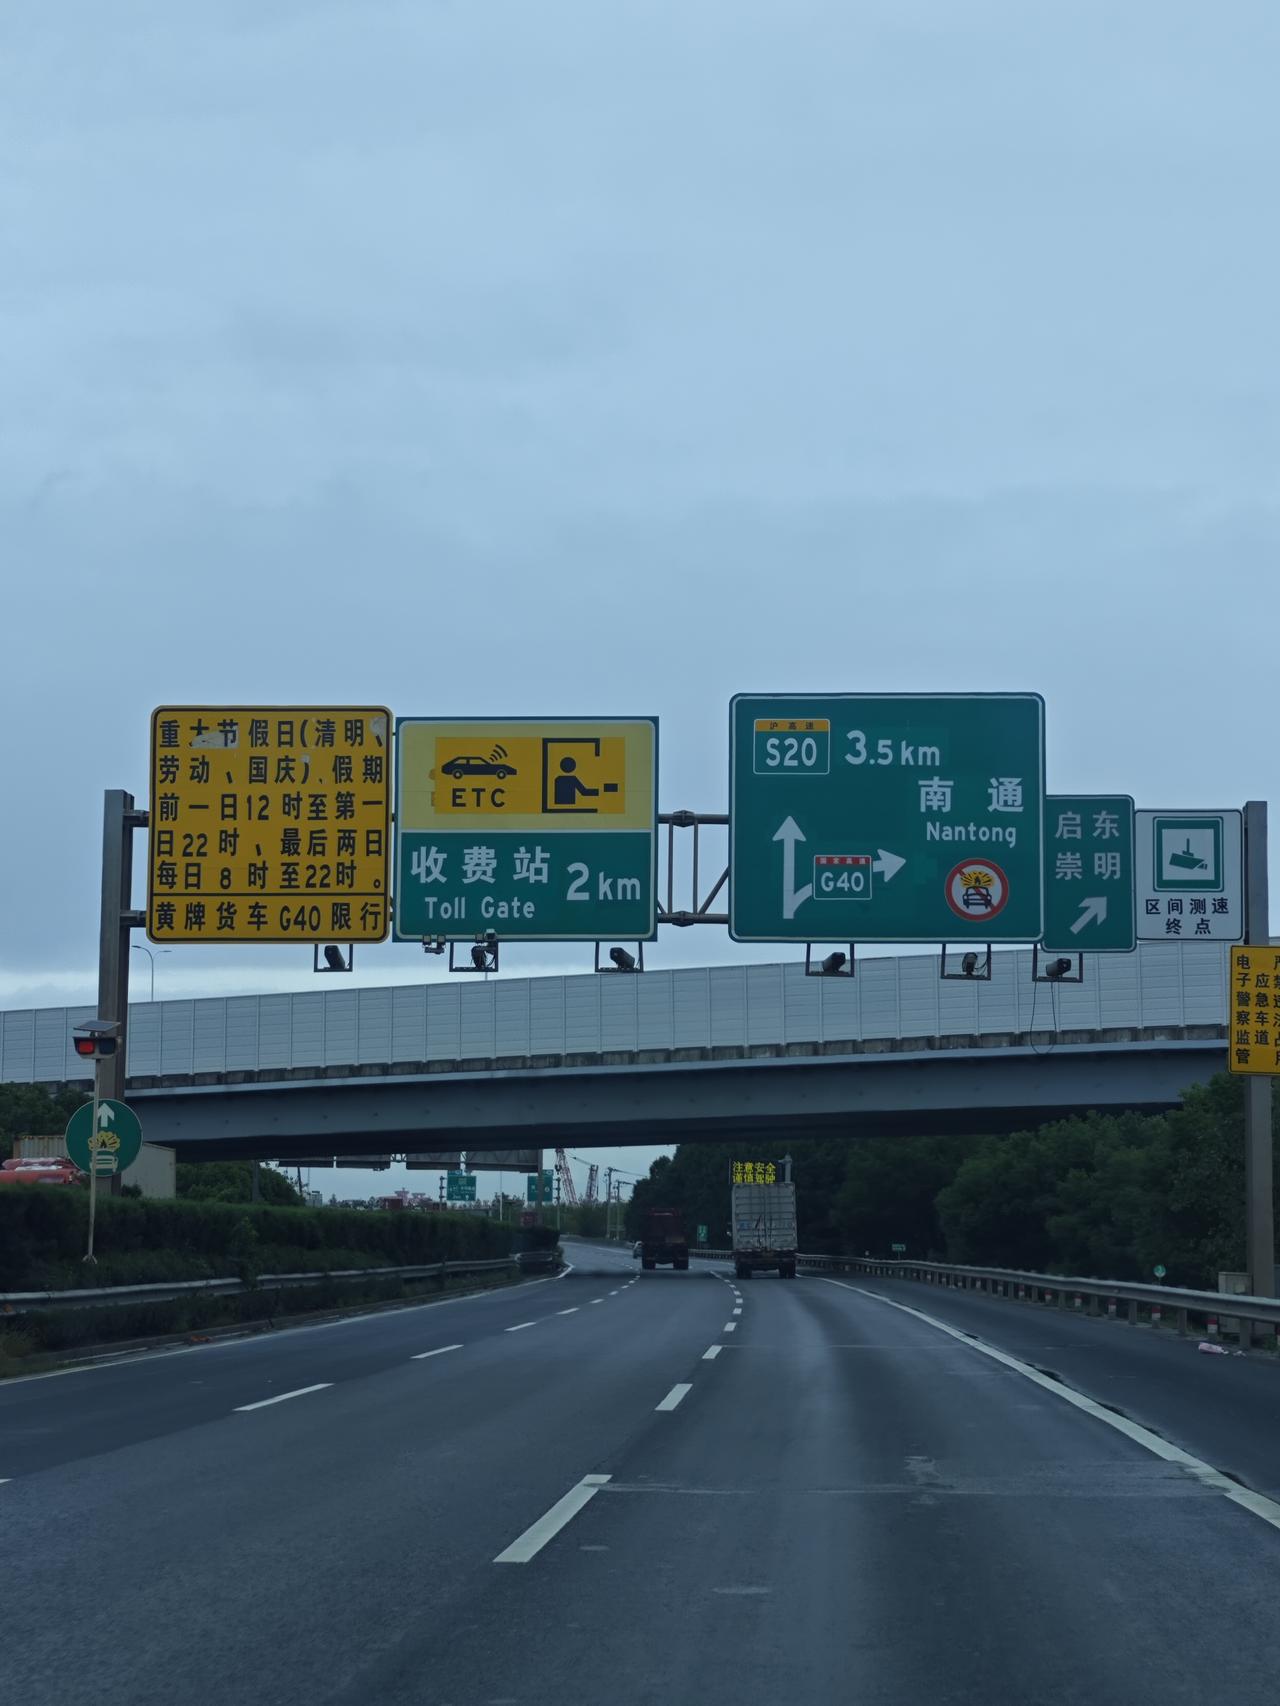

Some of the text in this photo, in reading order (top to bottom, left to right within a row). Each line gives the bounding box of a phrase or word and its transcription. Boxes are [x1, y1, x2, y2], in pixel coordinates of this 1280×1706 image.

[769, 721, 815, 730] 沪高速
[765, 737, 817, 767] S20
[451, 787, 506, 808] ETC
[918, 776, 1024, 813] 南通
[926, 821, 1017, 848] Nantong
[1054, 810, 1120, 840] 启东
[410, 845, 551, 884] 收费站
[1055, 851, 1121, 881] 崇明
[820, 871, 865, 892] G40
[155, 901, 382, 931] 黄牌货车G40限行
[425, 895, 535, 919] Toll Gate
[1145, 897, 1230, 916] 区间测速
[1165, 917, 1212, 935] 终点
[1235, 953, 1251, 1065] 电子警察监管
[1254, 972, 1270, 1046] 应急车道
